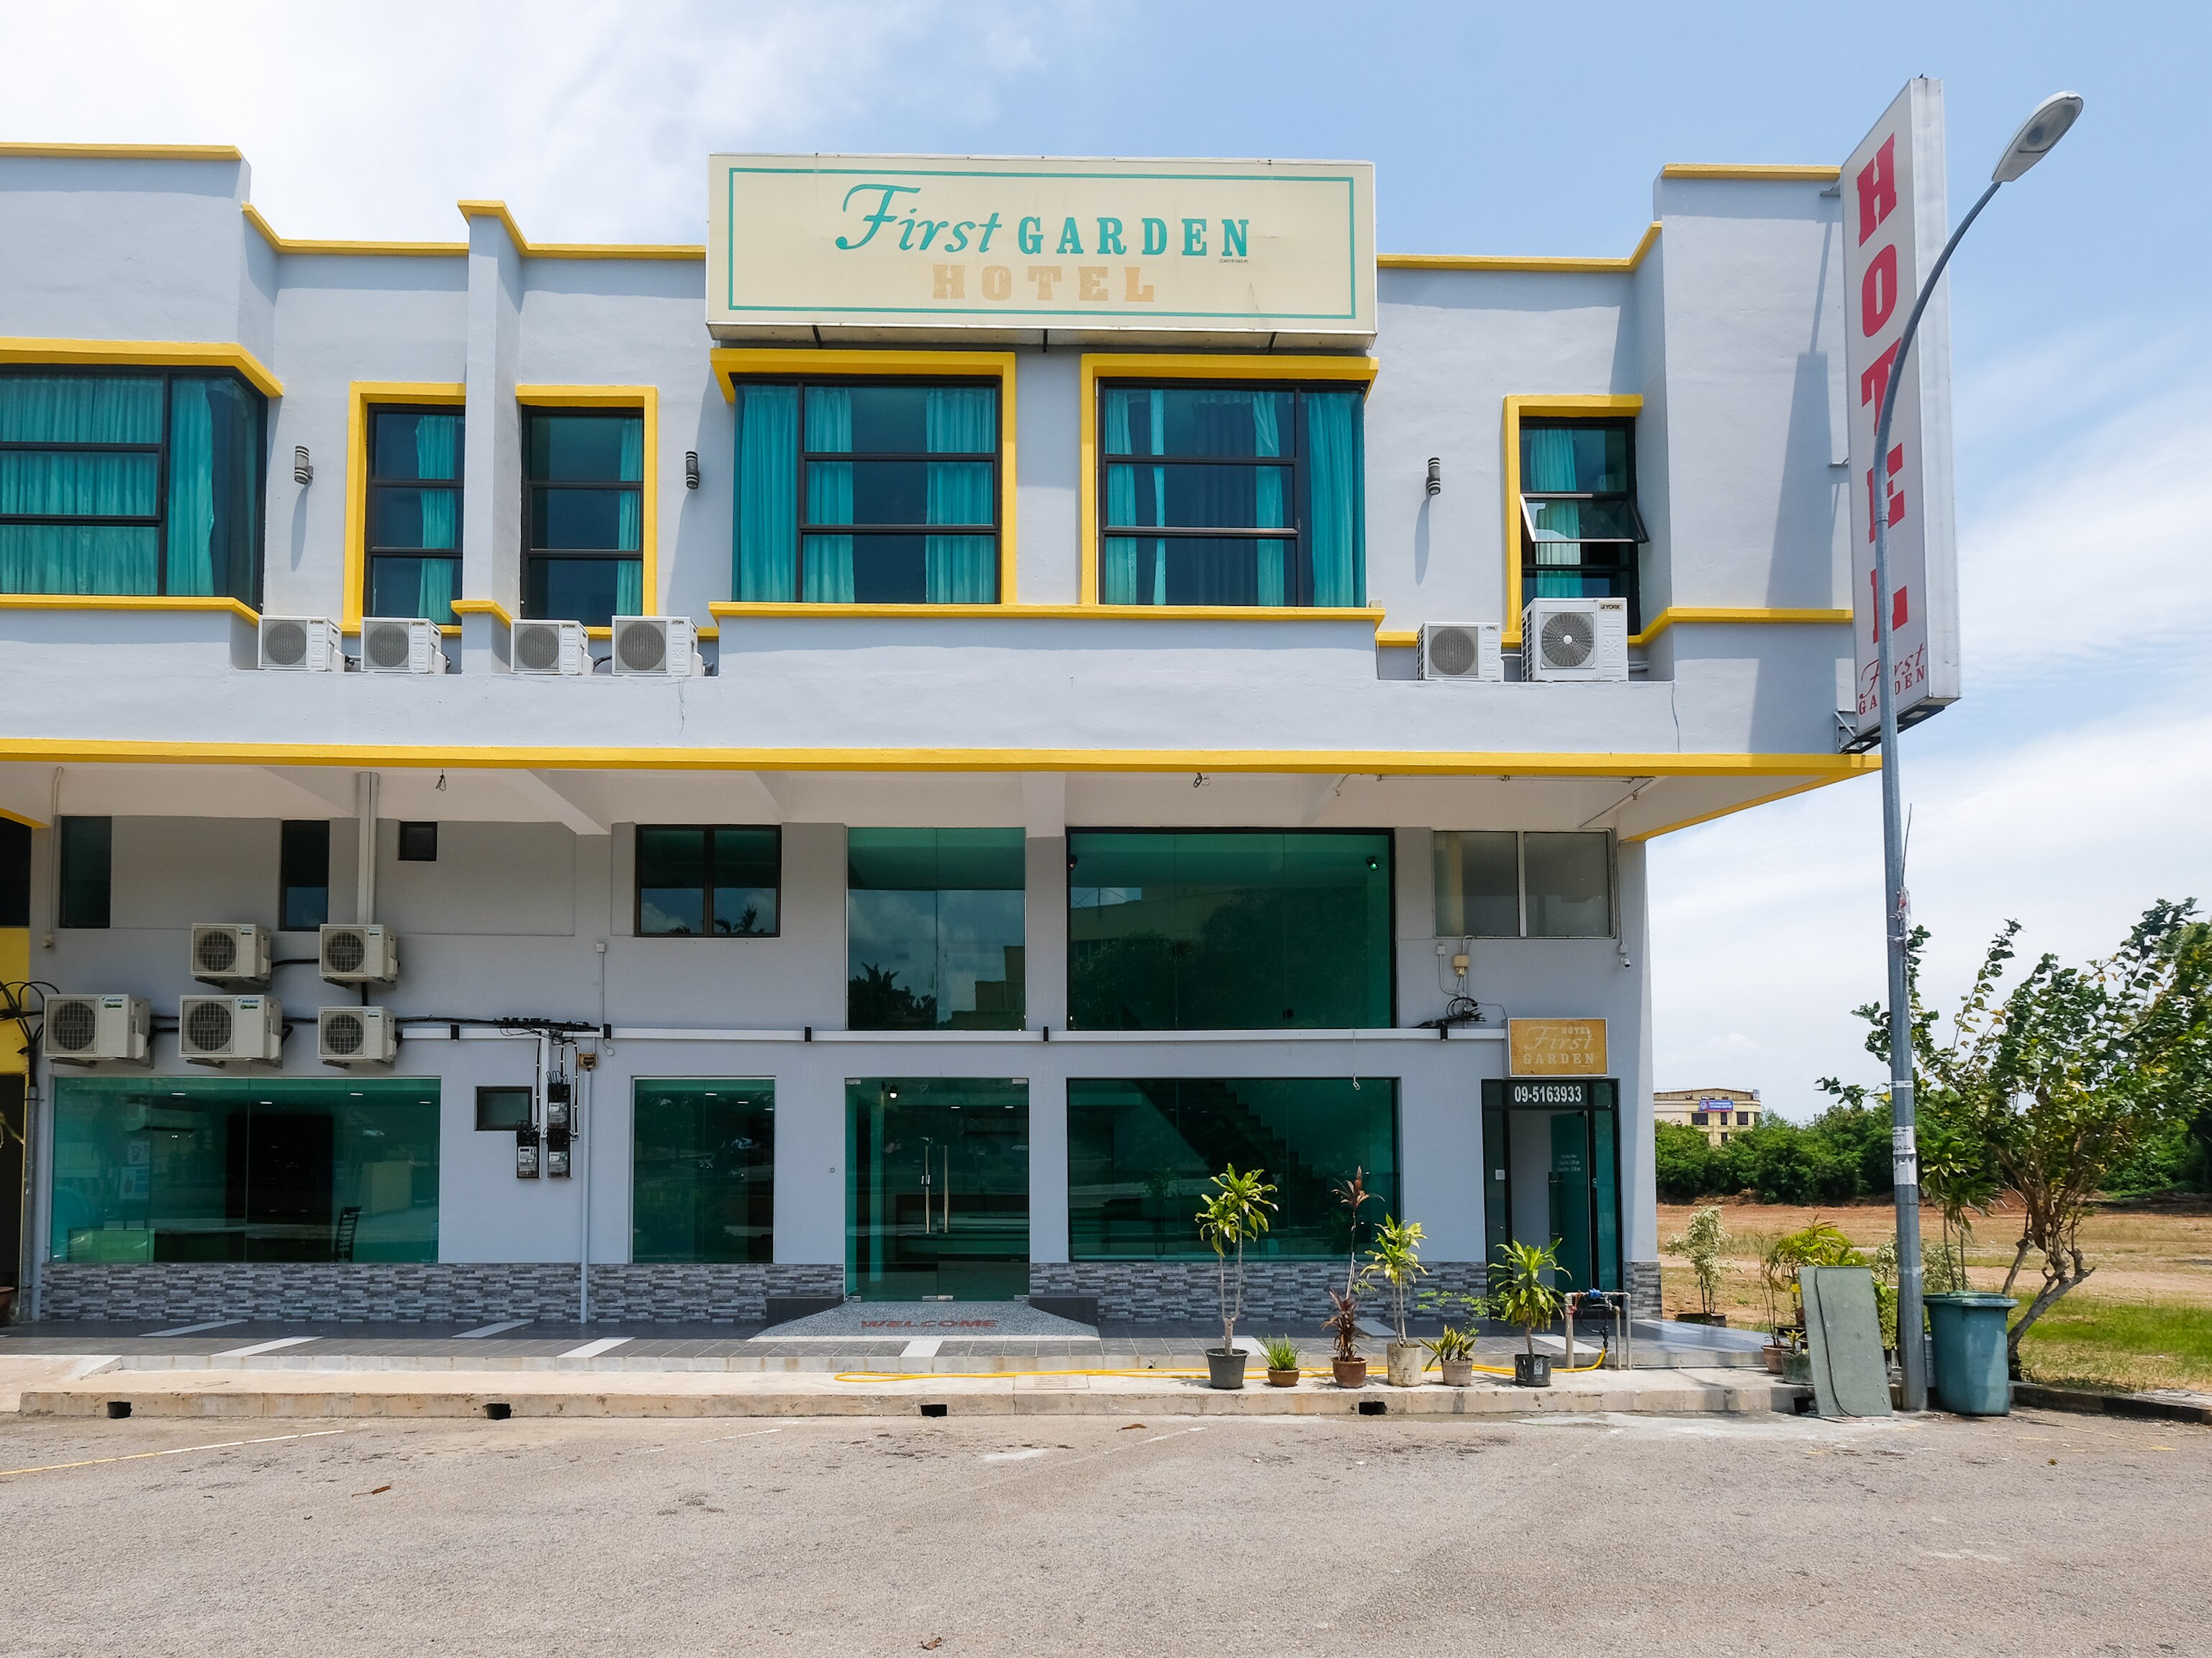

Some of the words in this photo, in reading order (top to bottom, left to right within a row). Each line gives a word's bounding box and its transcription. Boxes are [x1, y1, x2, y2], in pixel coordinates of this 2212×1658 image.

[835, 184, 1002, 253] First
[1018, 216, 1249, 257] GARDEN
[933, 264, 1154, 302] HOTEL
[1859, 643, 1926, 699] Frst
[1859, 664, 1925, 715] GADEN
[1523, 1026, 1594, 1050] First
[1523, 1053, 1595, 1064] GARDEN
[1514, 1085, 1582, 1103] 09-5163933
